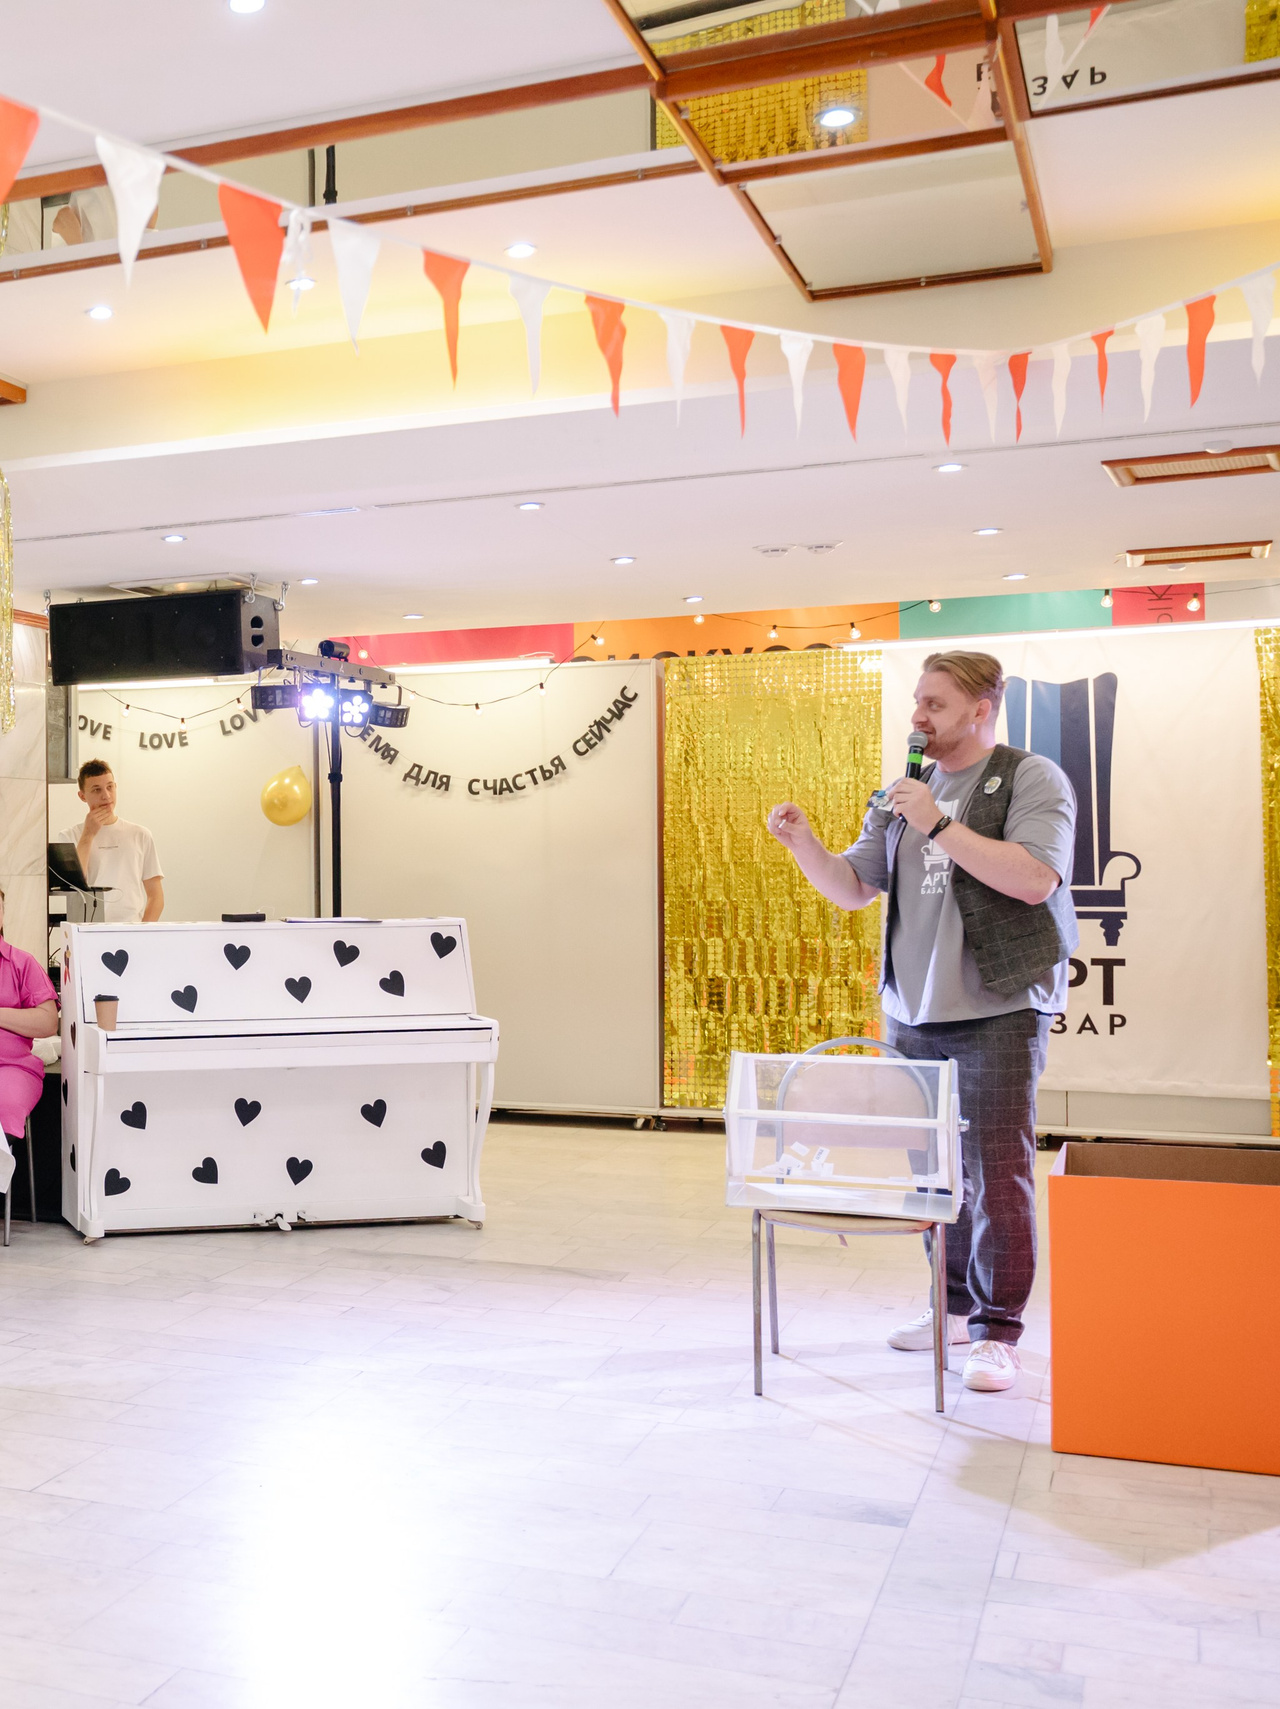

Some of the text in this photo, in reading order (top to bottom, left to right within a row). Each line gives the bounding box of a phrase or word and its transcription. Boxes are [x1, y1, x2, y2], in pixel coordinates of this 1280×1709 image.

[78, 709, 261, 750] OVE LOVE LOV
[359, 685, 639, 796] ЕМЯ ДЛЯ СЧАСТЬЯ СЕЙЧАС
[920, 887, 944, 895] БАЗА
[921, 871, 950, 888] АРТ
[1068, 957, 1126, 1006] РТ
[1049, 1012, 1127, 1036] ЗАР
